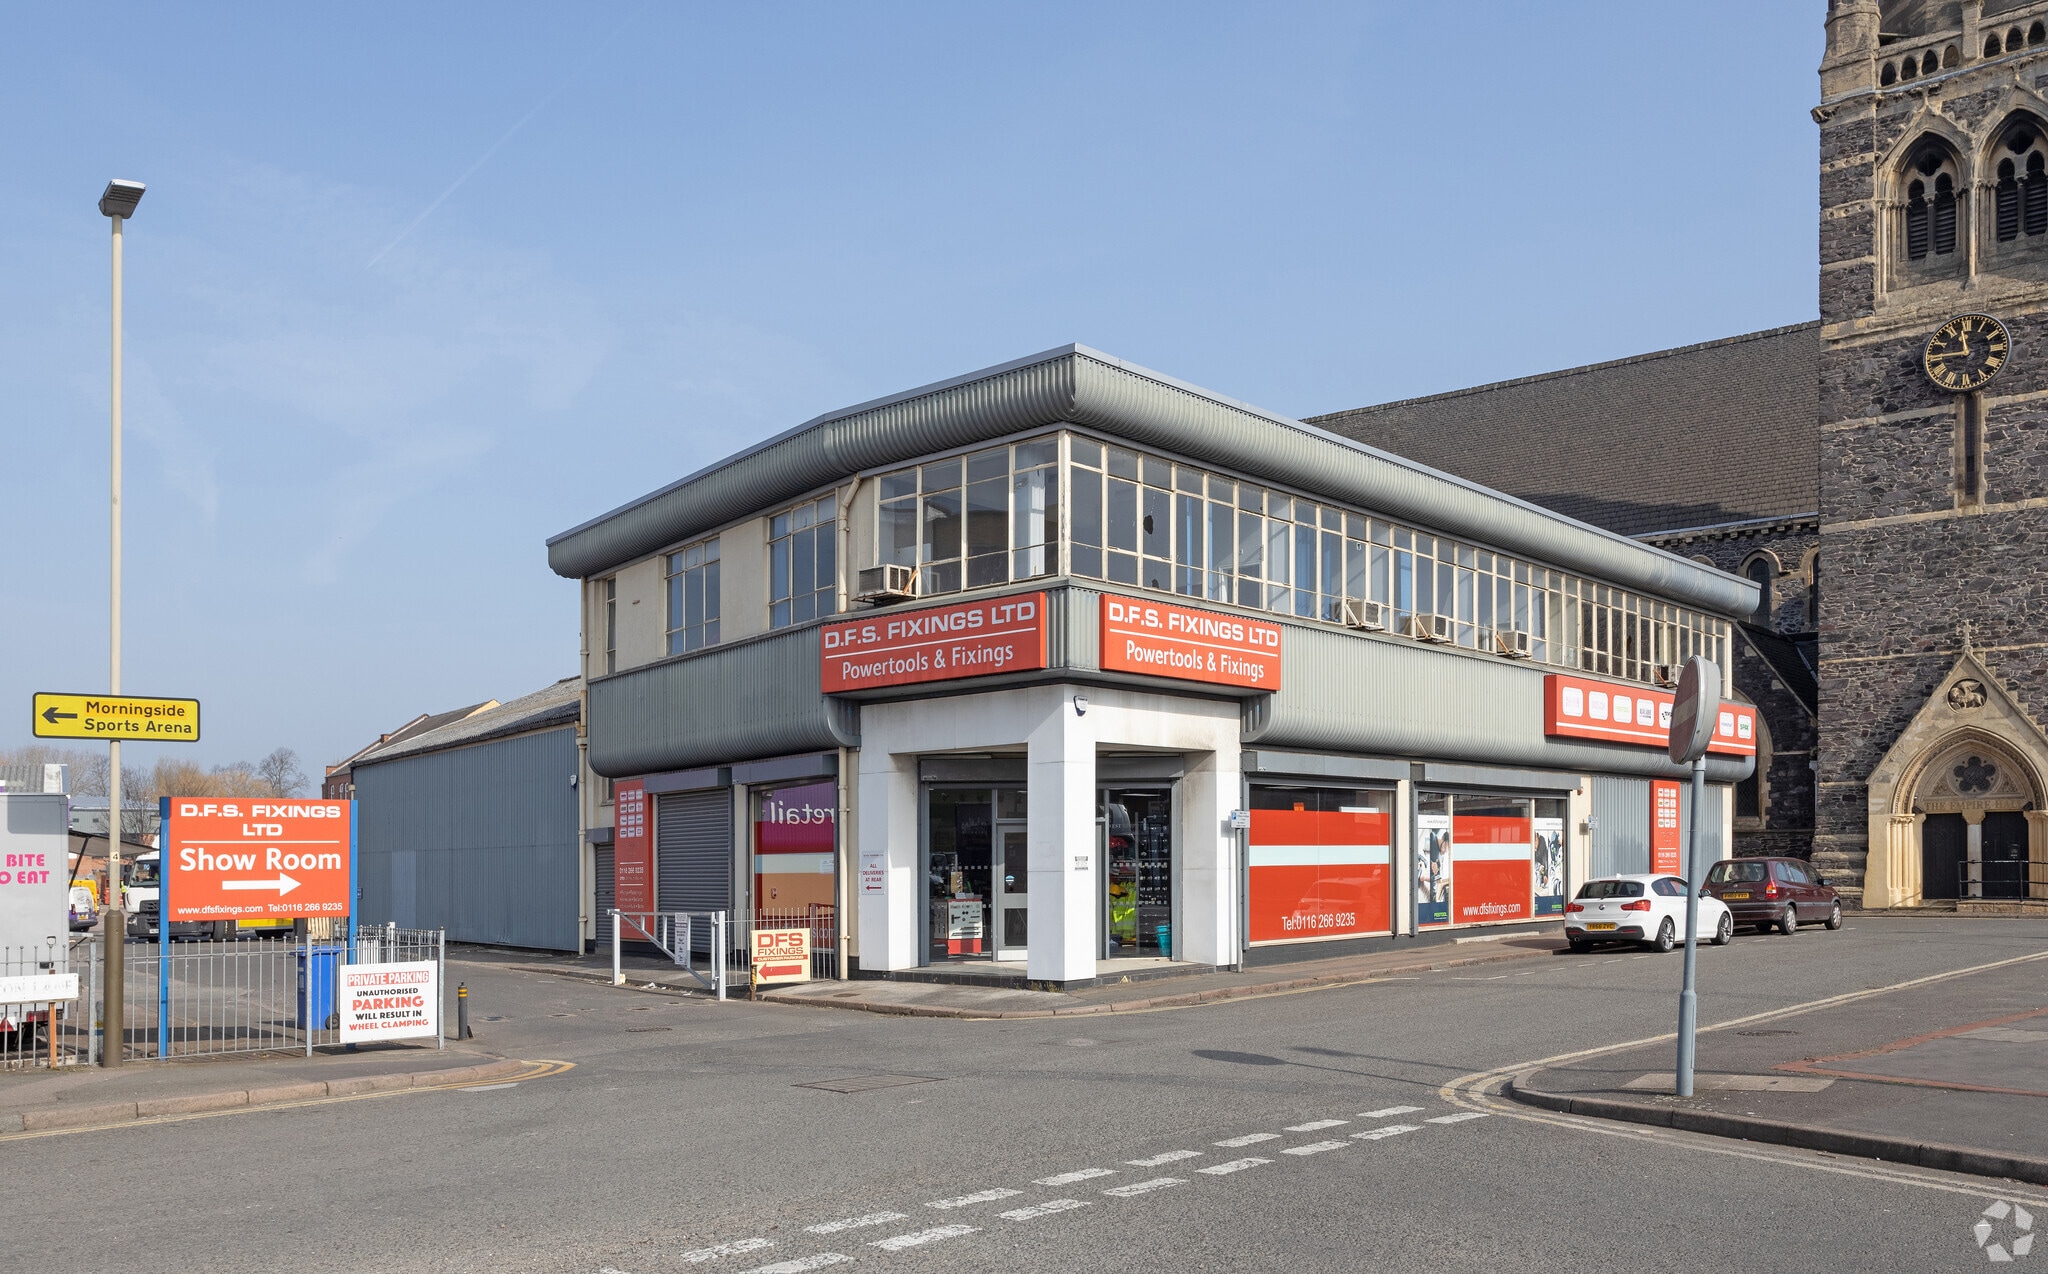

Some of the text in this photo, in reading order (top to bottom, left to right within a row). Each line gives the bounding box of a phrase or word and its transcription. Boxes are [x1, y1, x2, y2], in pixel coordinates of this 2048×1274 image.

[824, 601, 1036, 649] D.F.S. FIXINGS LTD
[1108, 602, 1279, 647] D.F.S. FIXINGS LTD
[842, 644, 1014, 680] Powertools & Fixings
[1126, 639, 1265, 682] Powertools & Fixings
[86, 701, 185, 718] Morningside
[84, 718, 192, 734] Sports Arena
[180, 803, 341, 818] D.F.S. FIXINGS
[1923, 802, 1946, 811] THE
[1950, 801, 1990, 811] EMPIRE
[242, 823, 283, 837] LTD
[6, 853, 45, 868] BITE
[180, 847, 342, 871] Show Room
[17, 870, 50, 884] EAT
[177, 902, 343, 915] www.dfsfixings.com Tel:0116 266 9235
[1462, 902, 1521, 917] www.dfsfixings.com
[1281, 912, 1356, 931] Tel:0116 266 9235
[757, 932, 804, 948] DFS
[757, 947, 804, 956] FIXINGS
[348, 971, 429, 987] PRIVATE PARKING
[356, 987, 419, 997] UNAUTHORISED
[352, 995, 425, 1011] PARKING
[355, 1012, 378, 1021] WILL
[379, 1010, 411, 1019] RESULT
[349, 1019, 429, 1031] WHEEL CLAMPING
